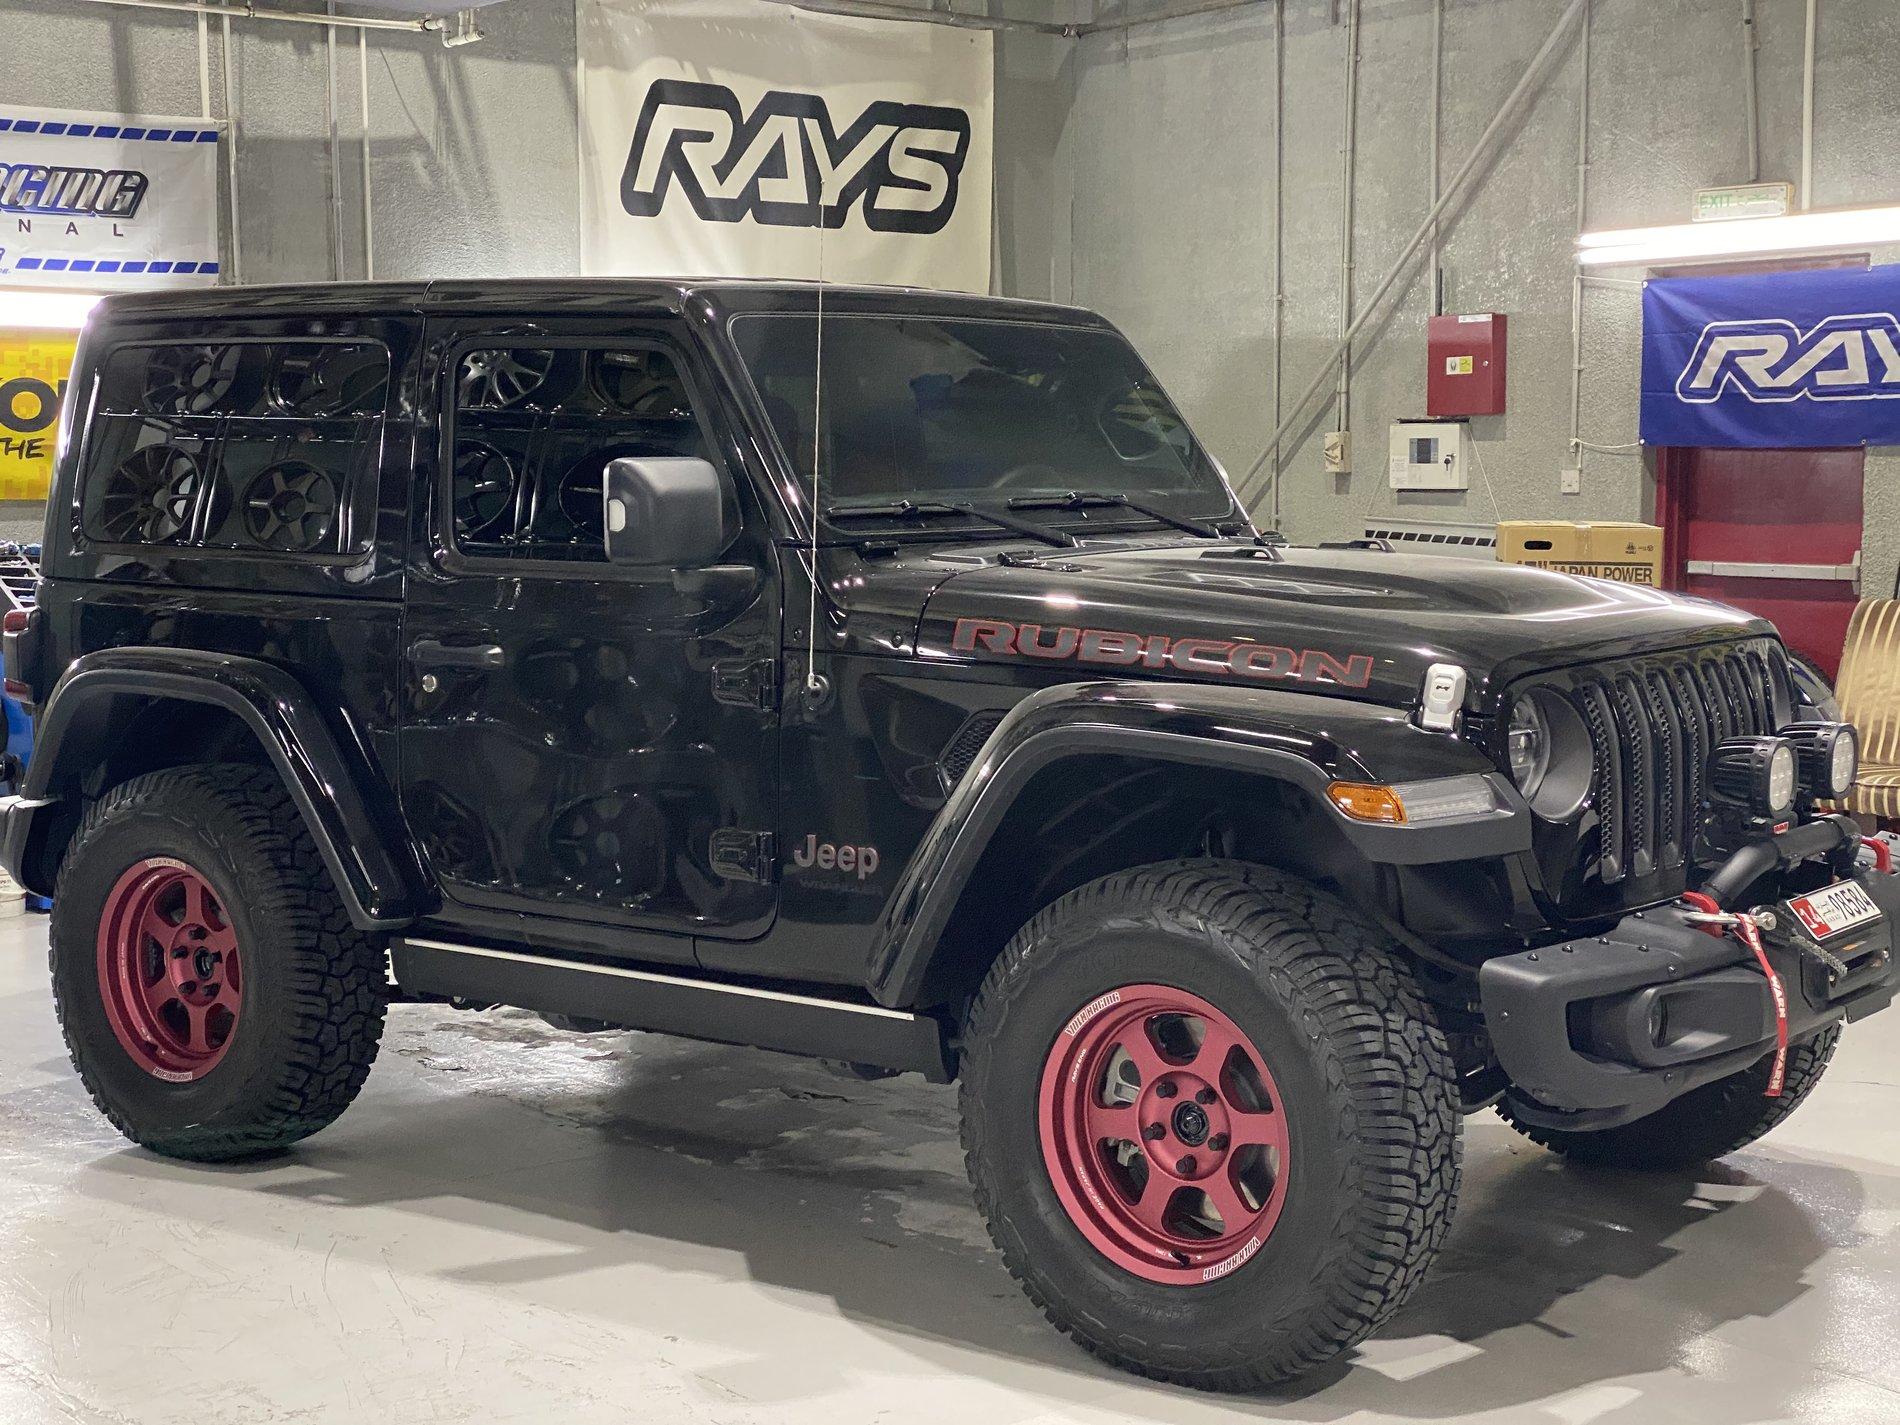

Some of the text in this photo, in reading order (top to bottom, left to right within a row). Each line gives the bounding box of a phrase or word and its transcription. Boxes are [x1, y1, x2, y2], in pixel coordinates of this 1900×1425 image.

[620, 78, 971, 234] RAYS
[0, 163, 149, 219] CING
[1699, 193, 1733, 209] EXIT
[0, 437, 46, 460] THE
[1603, 566, 1653, 583] POWER
[952, 617, 1374, 689] RUBICON
[793, 834, 879, 880] Jeep
[1799, 904, 1825, 929] 14
[1827, 885, 1876, 920] 98584
